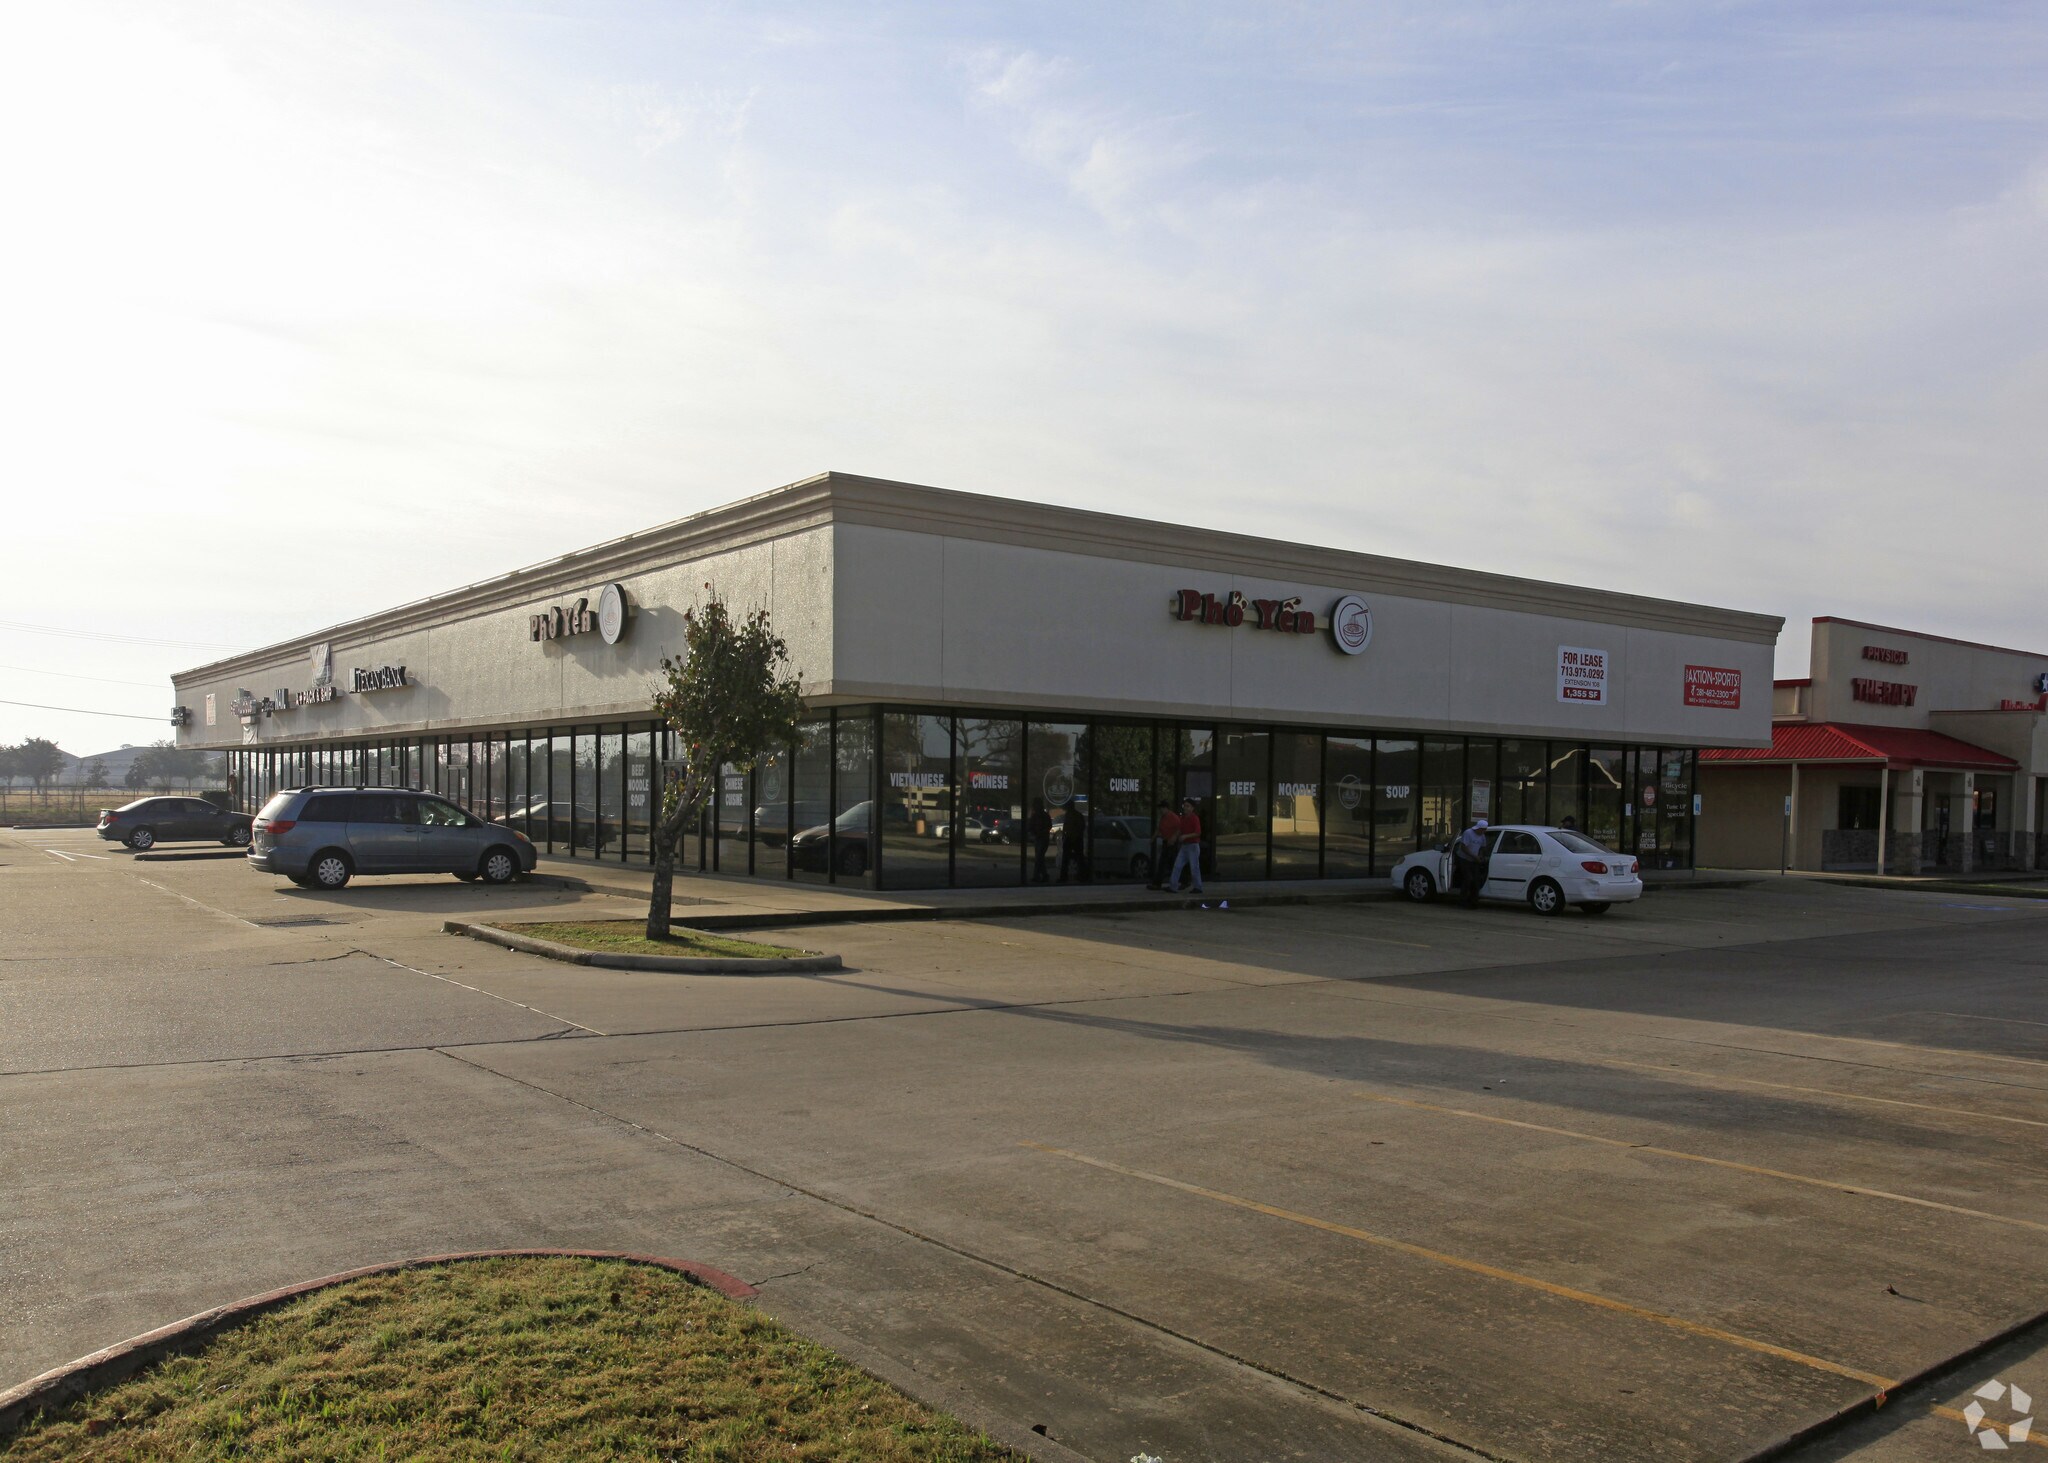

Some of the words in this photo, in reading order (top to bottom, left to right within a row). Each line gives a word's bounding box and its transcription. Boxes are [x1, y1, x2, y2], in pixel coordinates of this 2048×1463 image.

[1563, 652, 1578, 665] FOR
[1580, 653, 1603, 668] LEASE
[1863, 646, 1910, 665] PHYSICAL
[1561, 665, 1604, 680] 713.975.0292
[1564, 678, 1591, 687] EXTENSION
[1566, 689, 1587, 698] 1,355
[1588, 690, 1598, 699] SF
[1852, 678, 1918, 707] THERAPY
[632, 764, 645, 777] BEEF
[627, 778, 650, 792] NOODLE
[725, 777, 744, 791] CHINESE
[890, 772, 945, 788] VIETNAMESE
[972, 774, 1009, 790] CHINESE
[1109, 778, 1140, 793] CUISINE
[1229, 781, 1256, 796] BEEF
[1278, 783, 1317, 797] NOODLE
[1386, 785, 1411, 799] SOUP
[630, 793, 646, 807] SOUP
[725, 793, 743, 807] CUISINE
